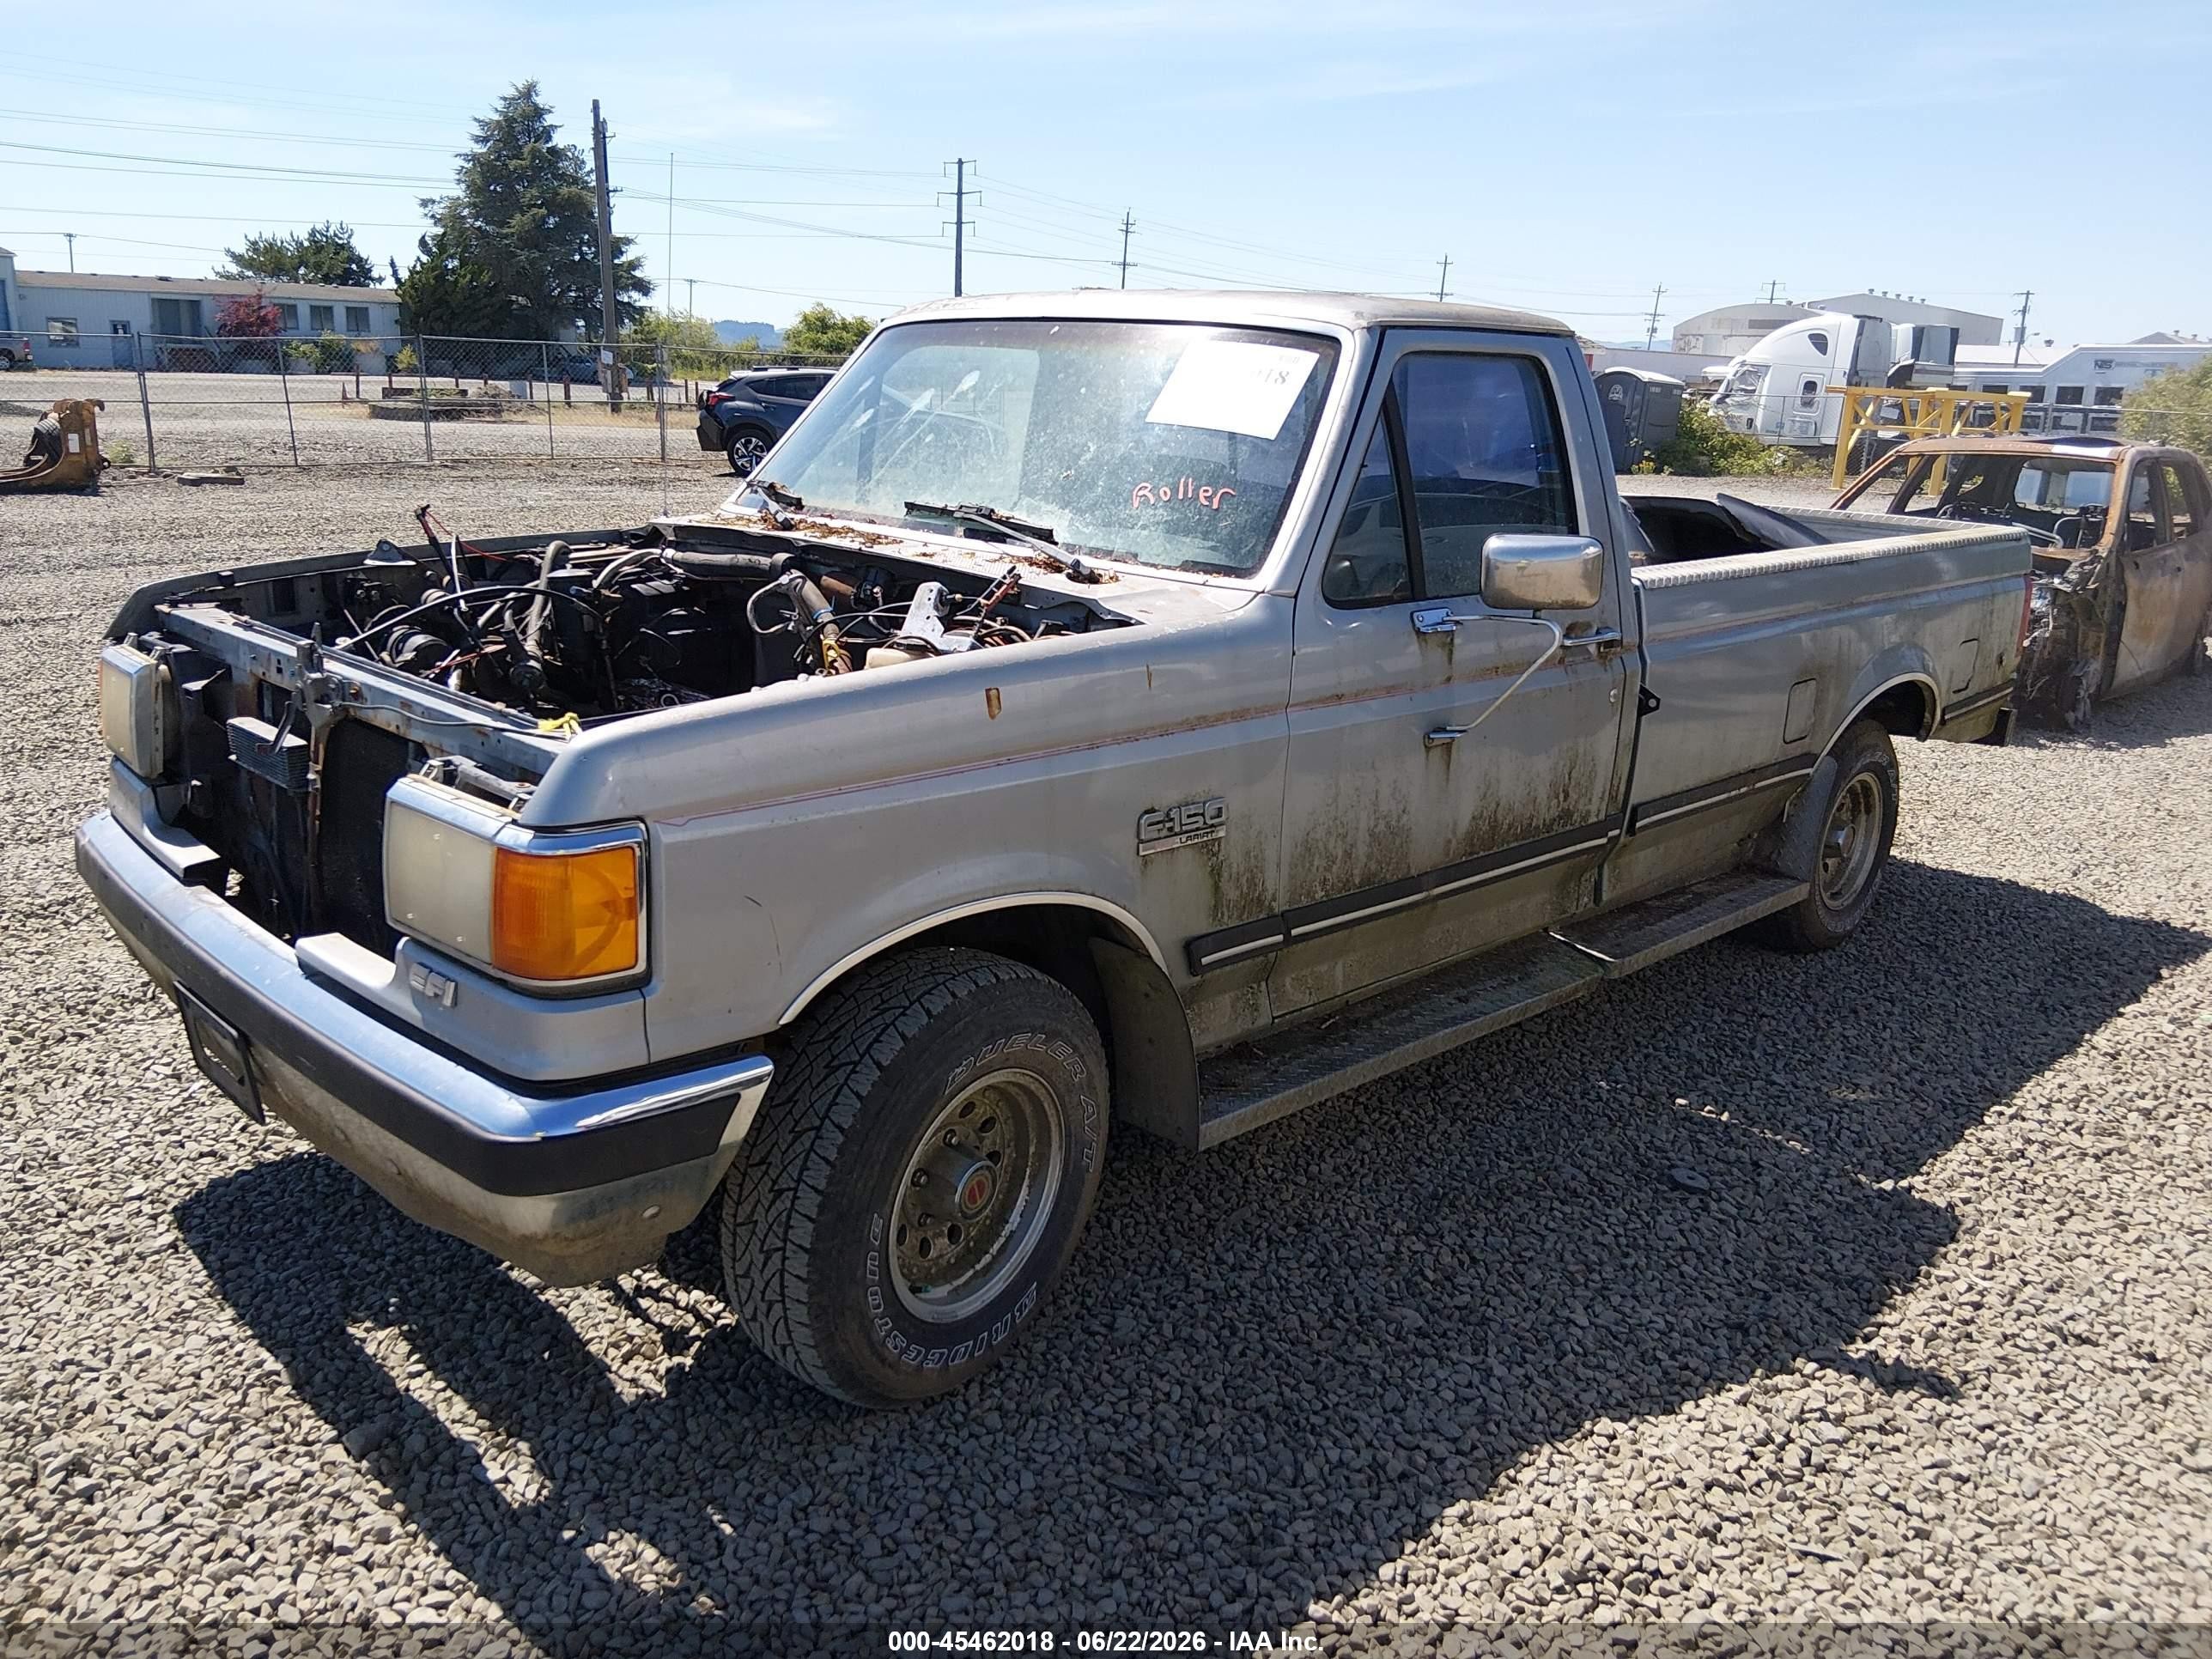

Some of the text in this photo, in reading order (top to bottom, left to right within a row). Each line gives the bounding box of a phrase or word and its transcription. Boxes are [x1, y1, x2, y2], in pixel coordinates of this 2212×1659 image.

[1133, 475, 1237, 509] Roller
[1138, 797, 1226, 840] F-150
[1179, 830, 1216, 844] LARIAT
[410, 963, 457, 1006] EFI
[945, 1033, 1097, 1173] DUELER A/T
[866, 1212, 1037, 1368] BRIDGESTONE
